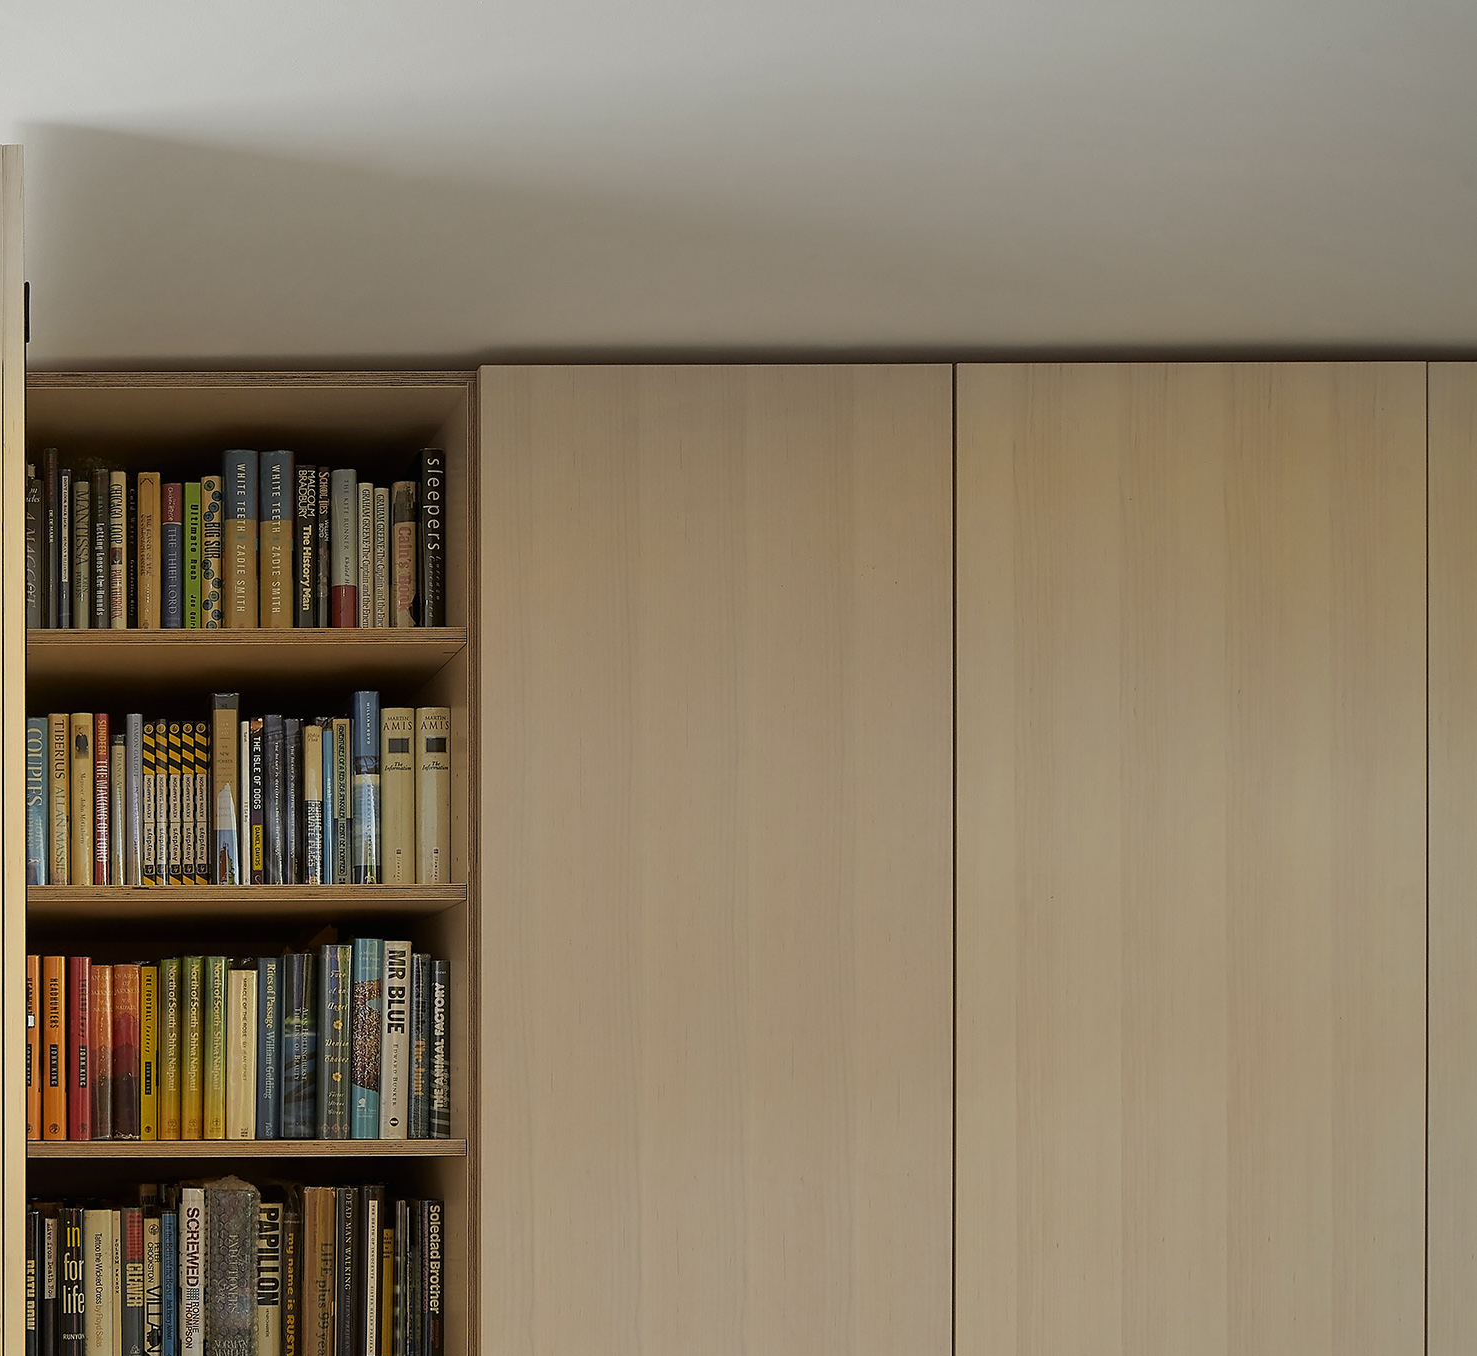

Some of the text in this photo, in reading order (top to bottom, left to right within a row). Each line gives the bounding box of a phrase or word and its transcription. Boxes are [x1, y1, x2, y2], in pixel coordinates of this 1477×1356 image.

[298, 470, 306, 519] BRADBURY
[306, 470, 315, 517] MALCOLM
[423, 458, 444, 551] sleepers
[75, 490, 89, 566] MANTISSA
[204, 522, 220, 558] BIG SUR
[236, 464, 245, 612] WHITE TEETH ZADIE SMITH
[300, 525, 312, 611] The History Man
[55, 720, 64, 780] TIBERIUS
[253, 736, 261, 810] THE ISLE OF DOGS
[56, 786, 64, 874] ALLAN MASSIE
[266, 964, 276, 1028] Rites of Passage
[388, 950, 406, 1034] MR BLUE
[264, 1031, 274, 1099] William Golding
[63, 1252, 84, 1281] for
[66, 1220, 80, 1248] in
[186, 1208, 200, 1288] SCREWED
[257, 1208, 279, 1306] PAPILLON
[286, 1232, 295, 1254] my
[430, 1204, 441, 1314] Soledad Brother
[63, 1285, 85, 1314] life
[126, 1263, 143, 1307] CLEAVER
[288, 1300, 295, 1310] is
